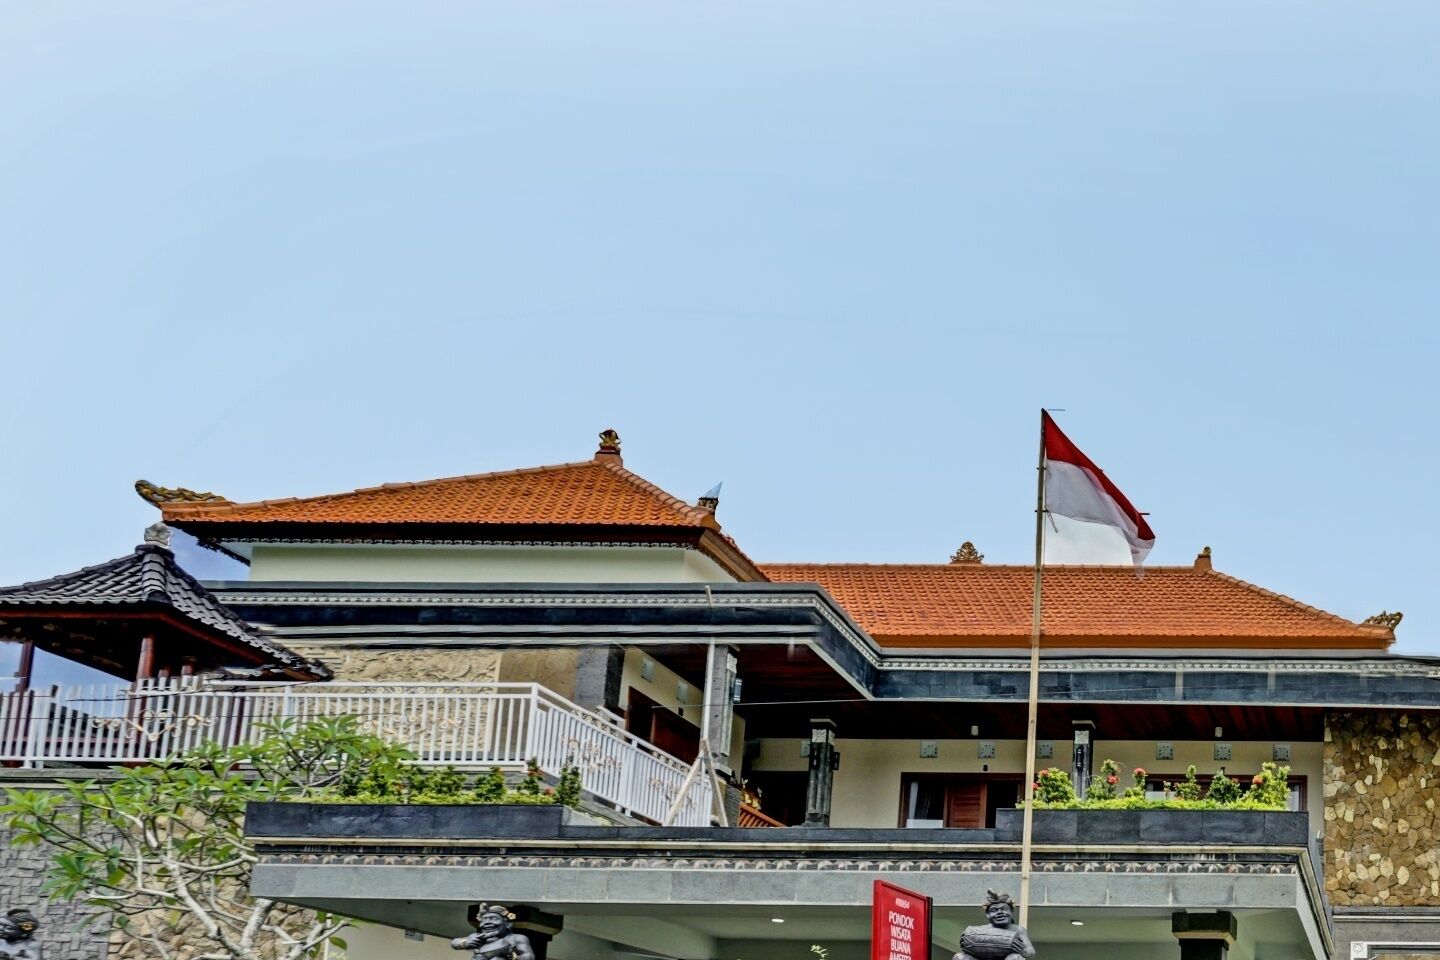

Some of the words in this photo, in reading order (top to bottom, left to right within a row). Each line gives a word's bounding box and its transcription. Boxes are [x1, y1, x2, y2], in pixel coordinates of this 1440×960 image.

[888, 911, 915, 930] PONDOK
[890, 925, 912, 942] WISATA
[890, 939, 911, 955] BUANA
